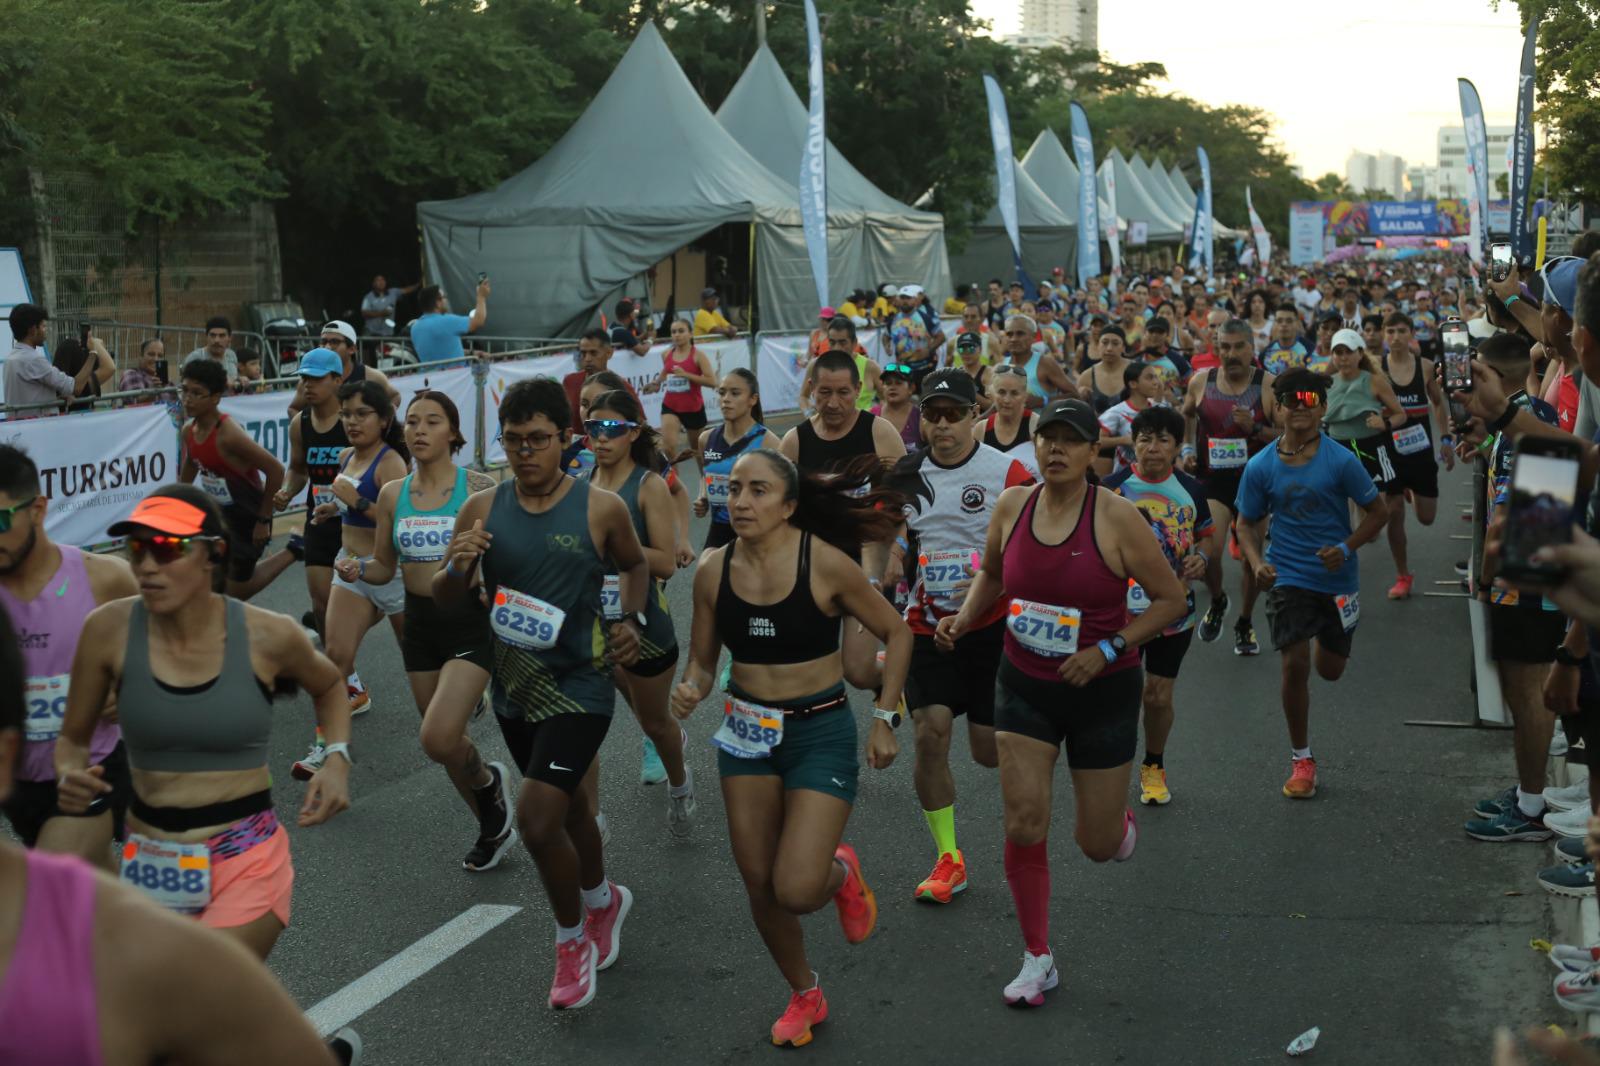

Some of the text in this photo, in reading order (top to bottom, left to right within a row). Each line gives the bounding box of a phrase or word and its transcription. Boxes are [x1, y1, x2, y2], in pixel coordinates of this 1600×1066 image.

[1380, 220, 1425, 231] SALIDA
[40, 451, 166, 499] TURISMO
[495, 606, 554, 642] 6239
[1013, 615, 1072, 642] 6714
[726, 714, 779, 746] 4938
[125, 859, 204, 893] 4888
